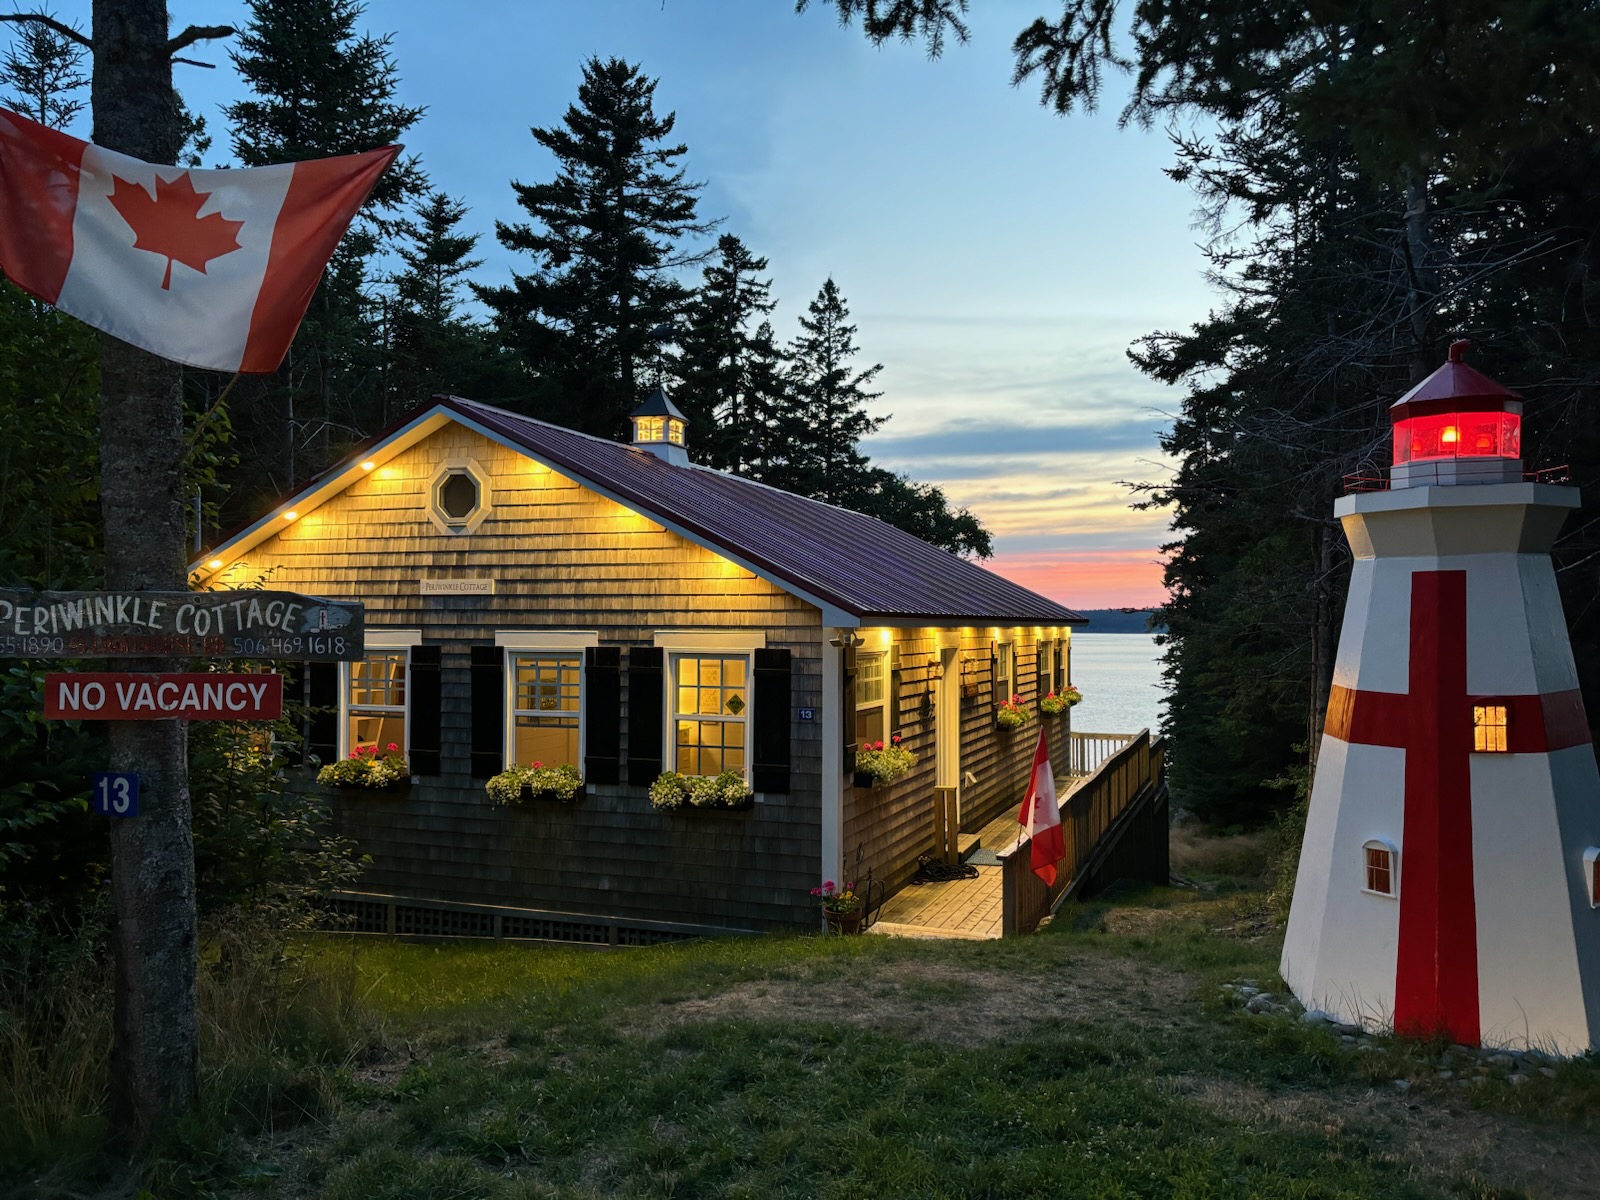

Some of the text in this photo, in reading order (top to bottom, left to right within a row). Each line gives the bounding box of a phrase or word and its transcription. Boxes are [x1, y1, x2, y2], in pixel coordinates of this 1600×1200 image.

[425, 582, 488, 591] PERIWINKLE COTTAGE
[0, 596, 302, 637] PERIWINKLE COTTAGE
[58, 682, 268, 711] NO VACANCY
[800, 710, 812, 719] 13
[99, 777, 130, 813] 13
